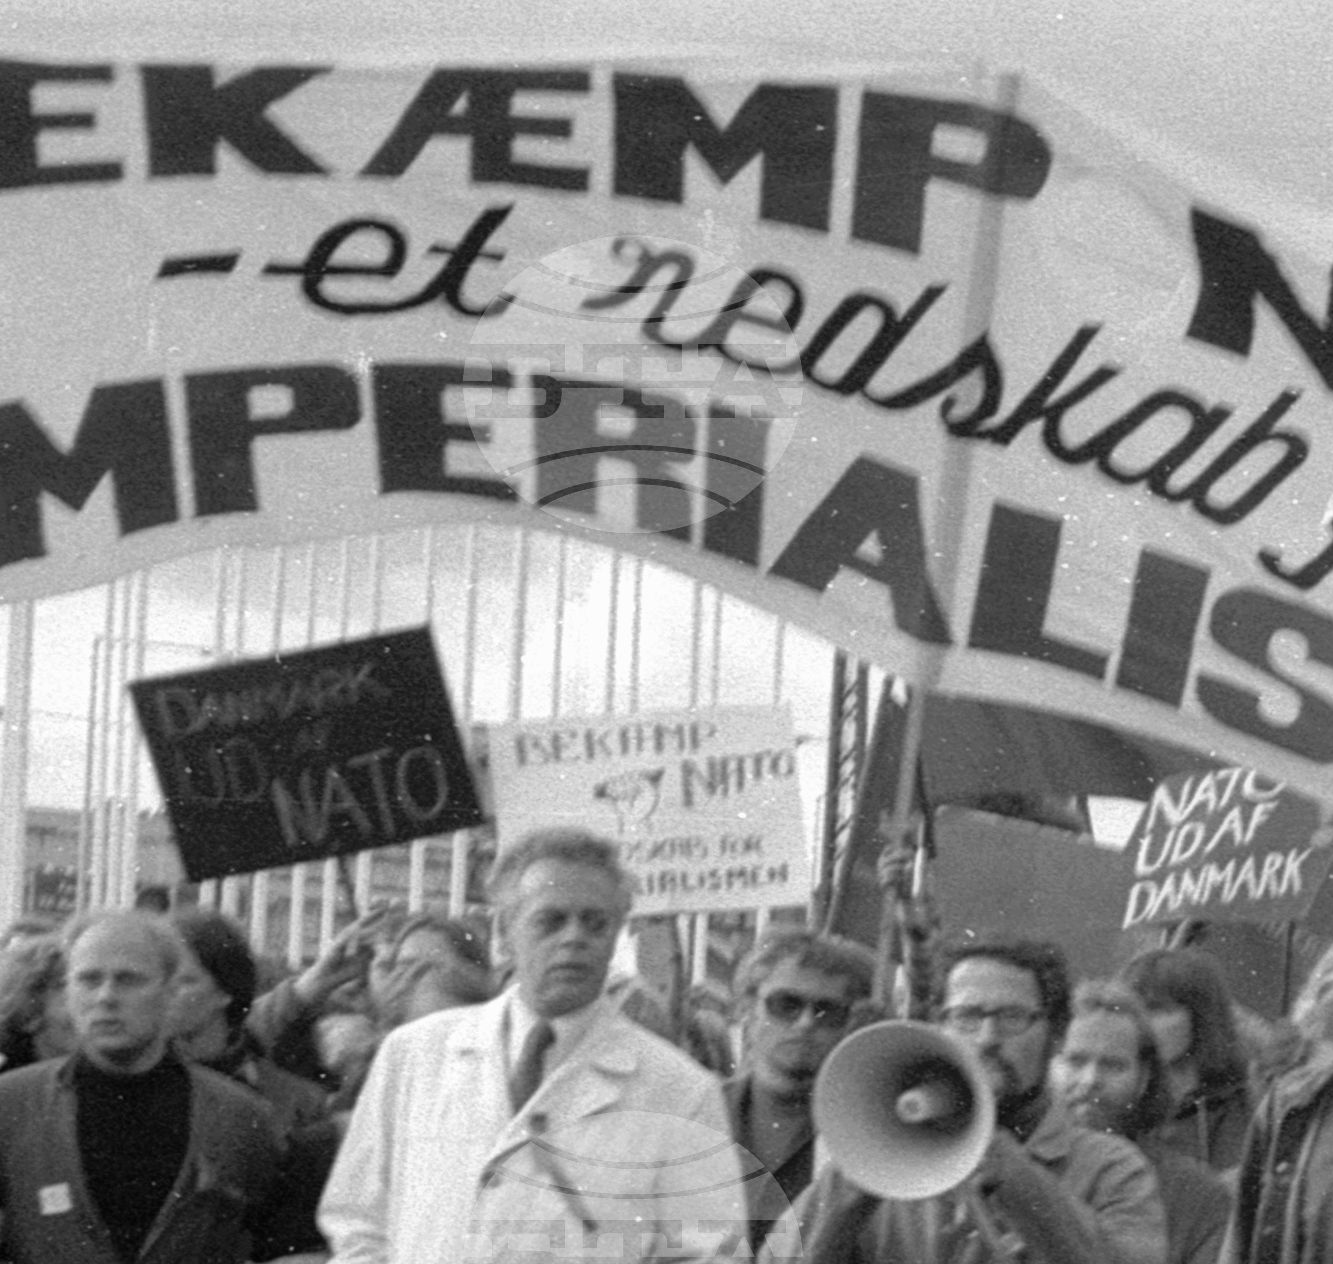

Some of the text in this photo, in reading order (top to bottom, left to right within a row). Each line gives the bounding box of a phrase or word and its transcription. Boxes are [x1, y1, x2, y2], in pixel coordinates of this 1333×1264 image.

[580, 236, 1309, 526] redskab
[271, 744, 449, 849] NATO
[680, 748, 795, 808] NATO
[1145, 766, 1287, 836] NATO
[1134, 800, 1279, 877] UD AF
[1121, 846, 1316, 931] DANMARK
